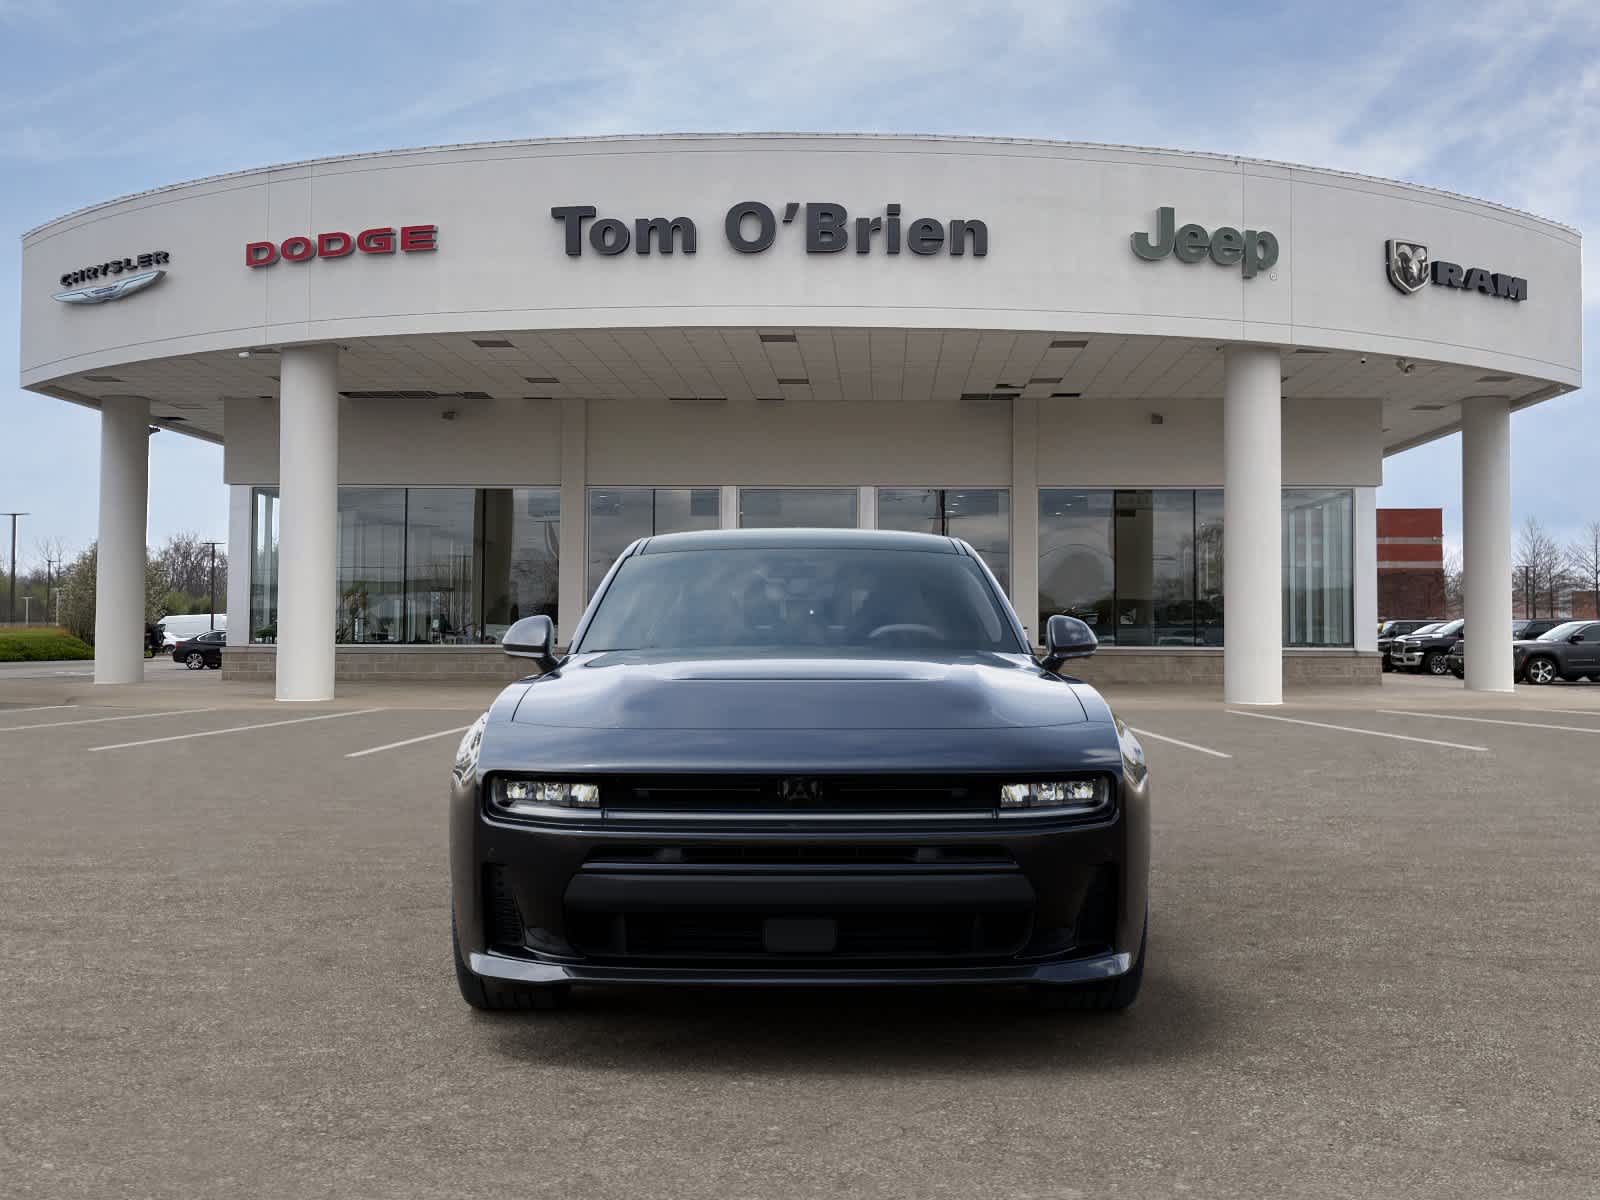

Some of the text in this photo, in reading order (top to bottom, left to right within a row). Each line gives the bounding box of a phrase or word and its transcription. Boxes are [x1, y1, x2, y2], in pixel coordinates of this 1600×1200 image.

[246, 225, 437, 269] DODGE
[551, 201, 988, 257] Tom O'Brien
[1131, 207, 1279, 279] Jeep
[60, 250, 170, 287] CHRYSLER
[1431, 261, 1528, 301] RAM
